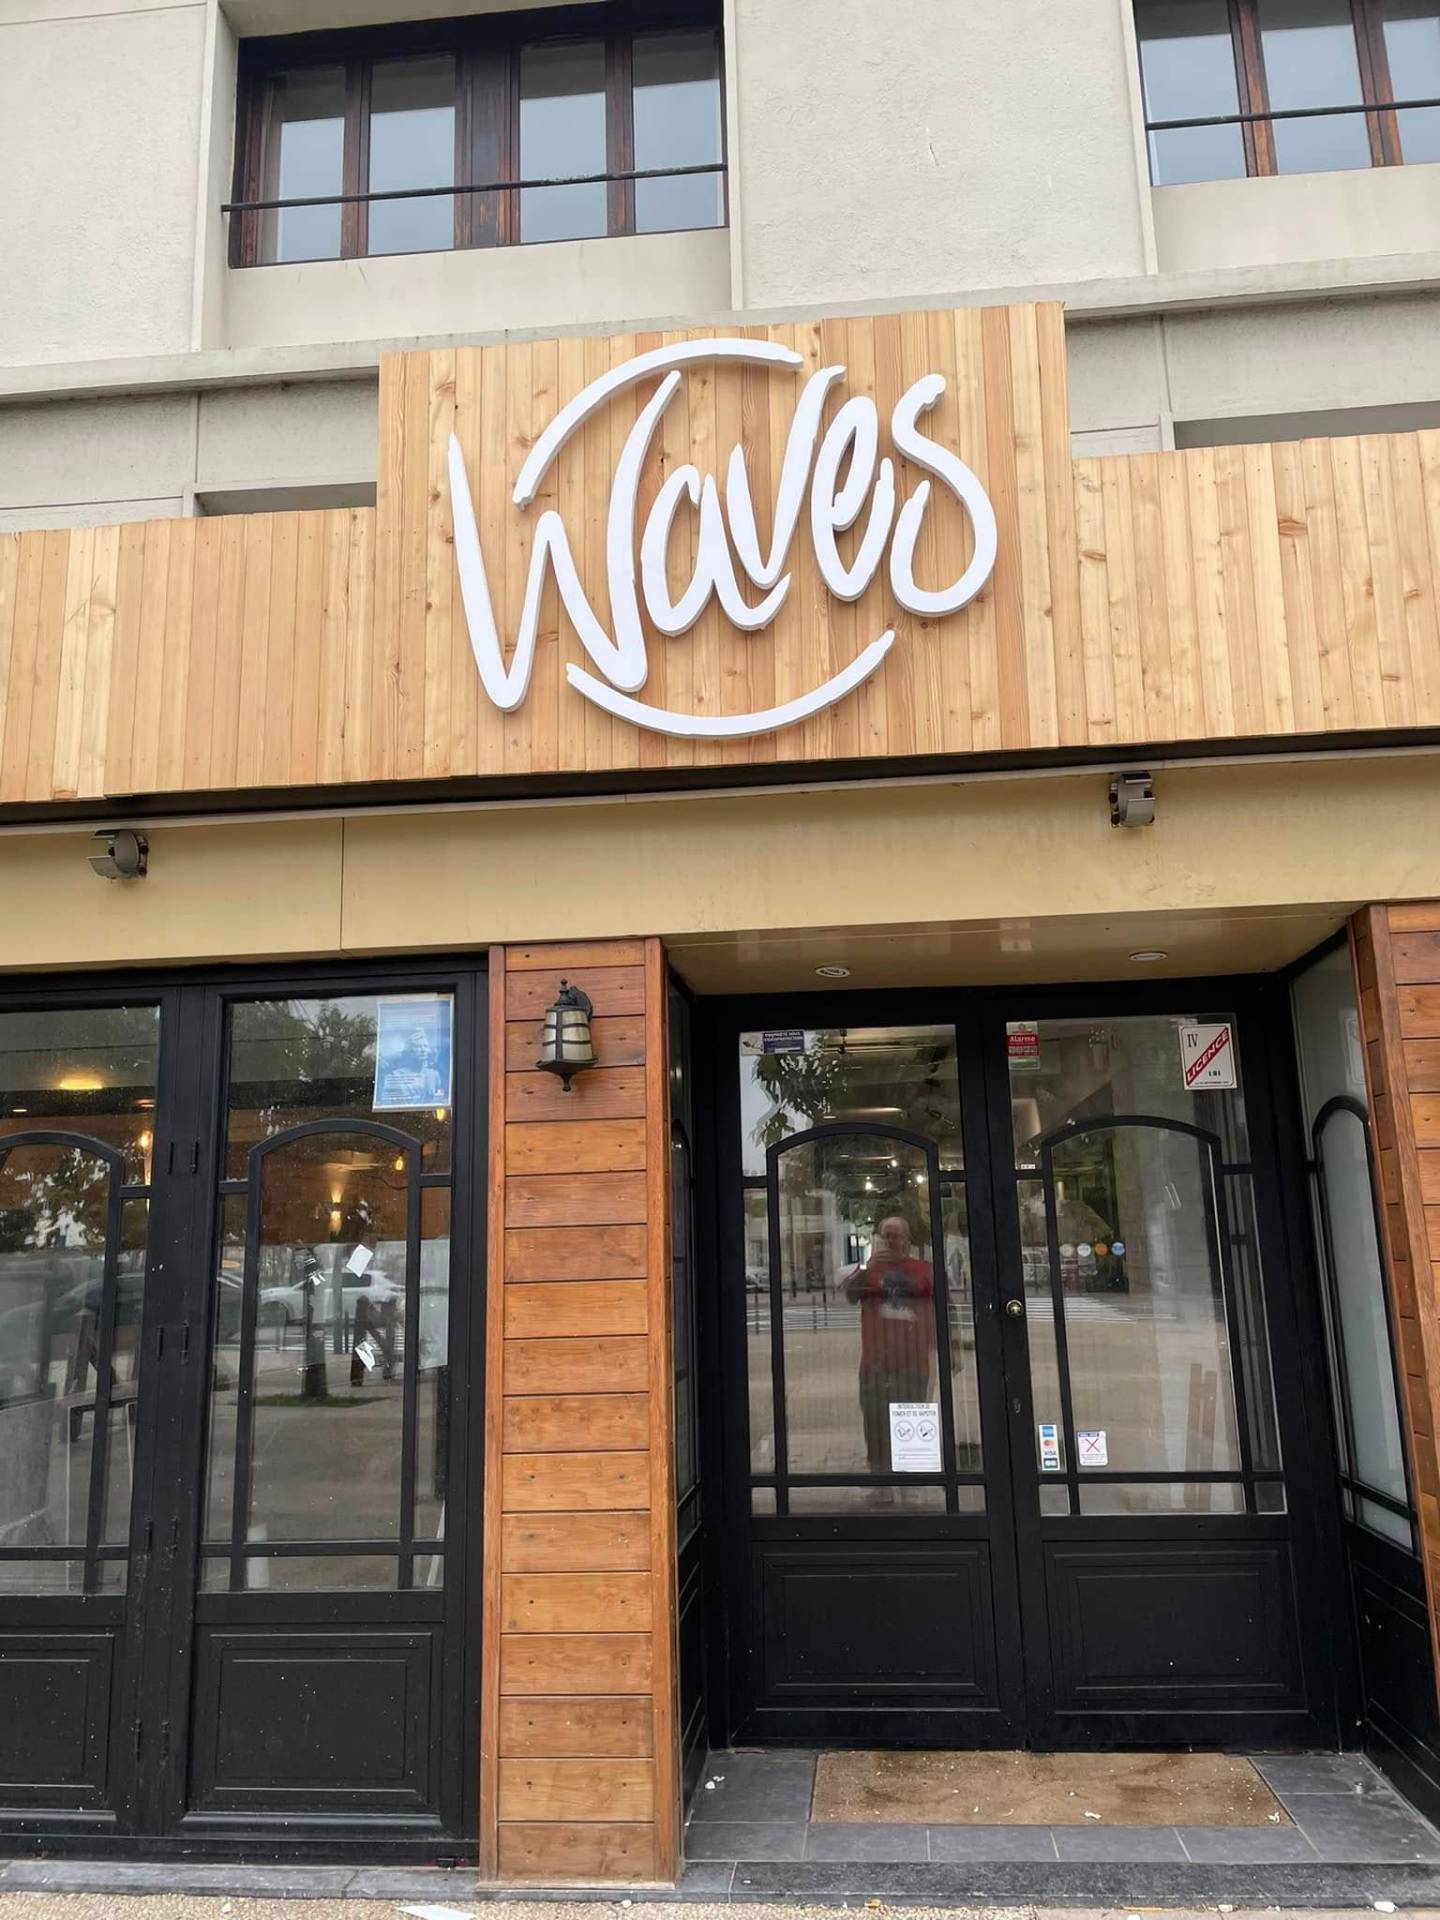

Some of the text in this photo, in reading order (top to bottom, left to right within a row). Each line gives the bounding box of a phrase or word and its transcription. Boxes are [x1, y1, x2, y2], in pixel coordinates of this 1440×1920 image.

[448, 364, 998, 712] Waves
[1187, 1033, 1198, 1047] IV
[1187, 1029, 1228, 1082] LICENCE
